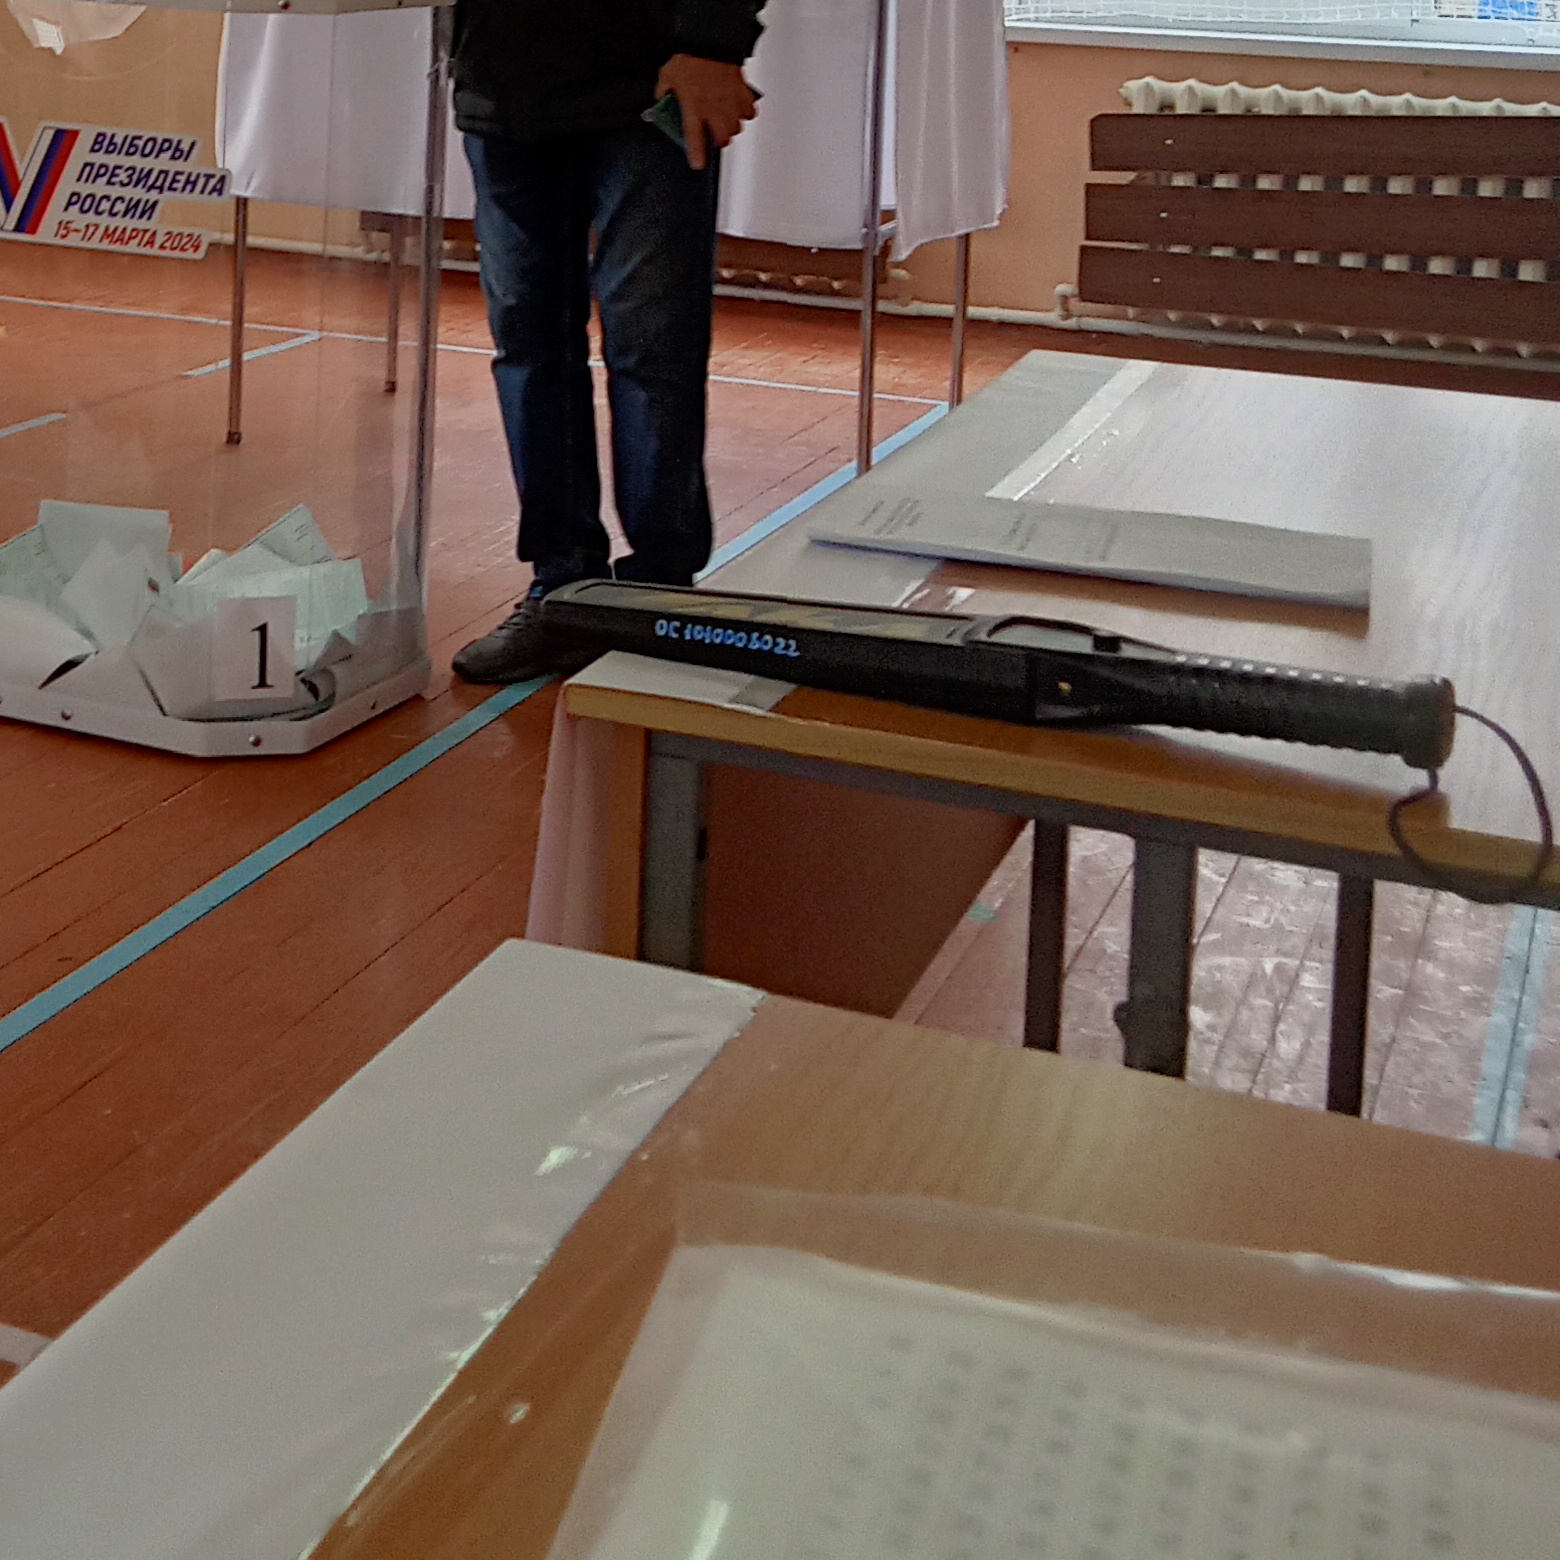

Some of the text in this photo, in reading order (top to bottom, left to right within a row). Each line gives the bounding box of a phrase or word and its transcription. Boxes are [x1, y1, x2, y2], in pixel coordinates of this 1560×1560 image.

[89, 131, 197, 163] ВЫБОРЫ
[75, 161, 230, 197] ПРЕЗИДЕНТА
[63, 191, 160, 222] РОССИИ
[53, 219, 203, 254] 15-17 МАРТА 2024
[250, 621, 275, 690] 1
